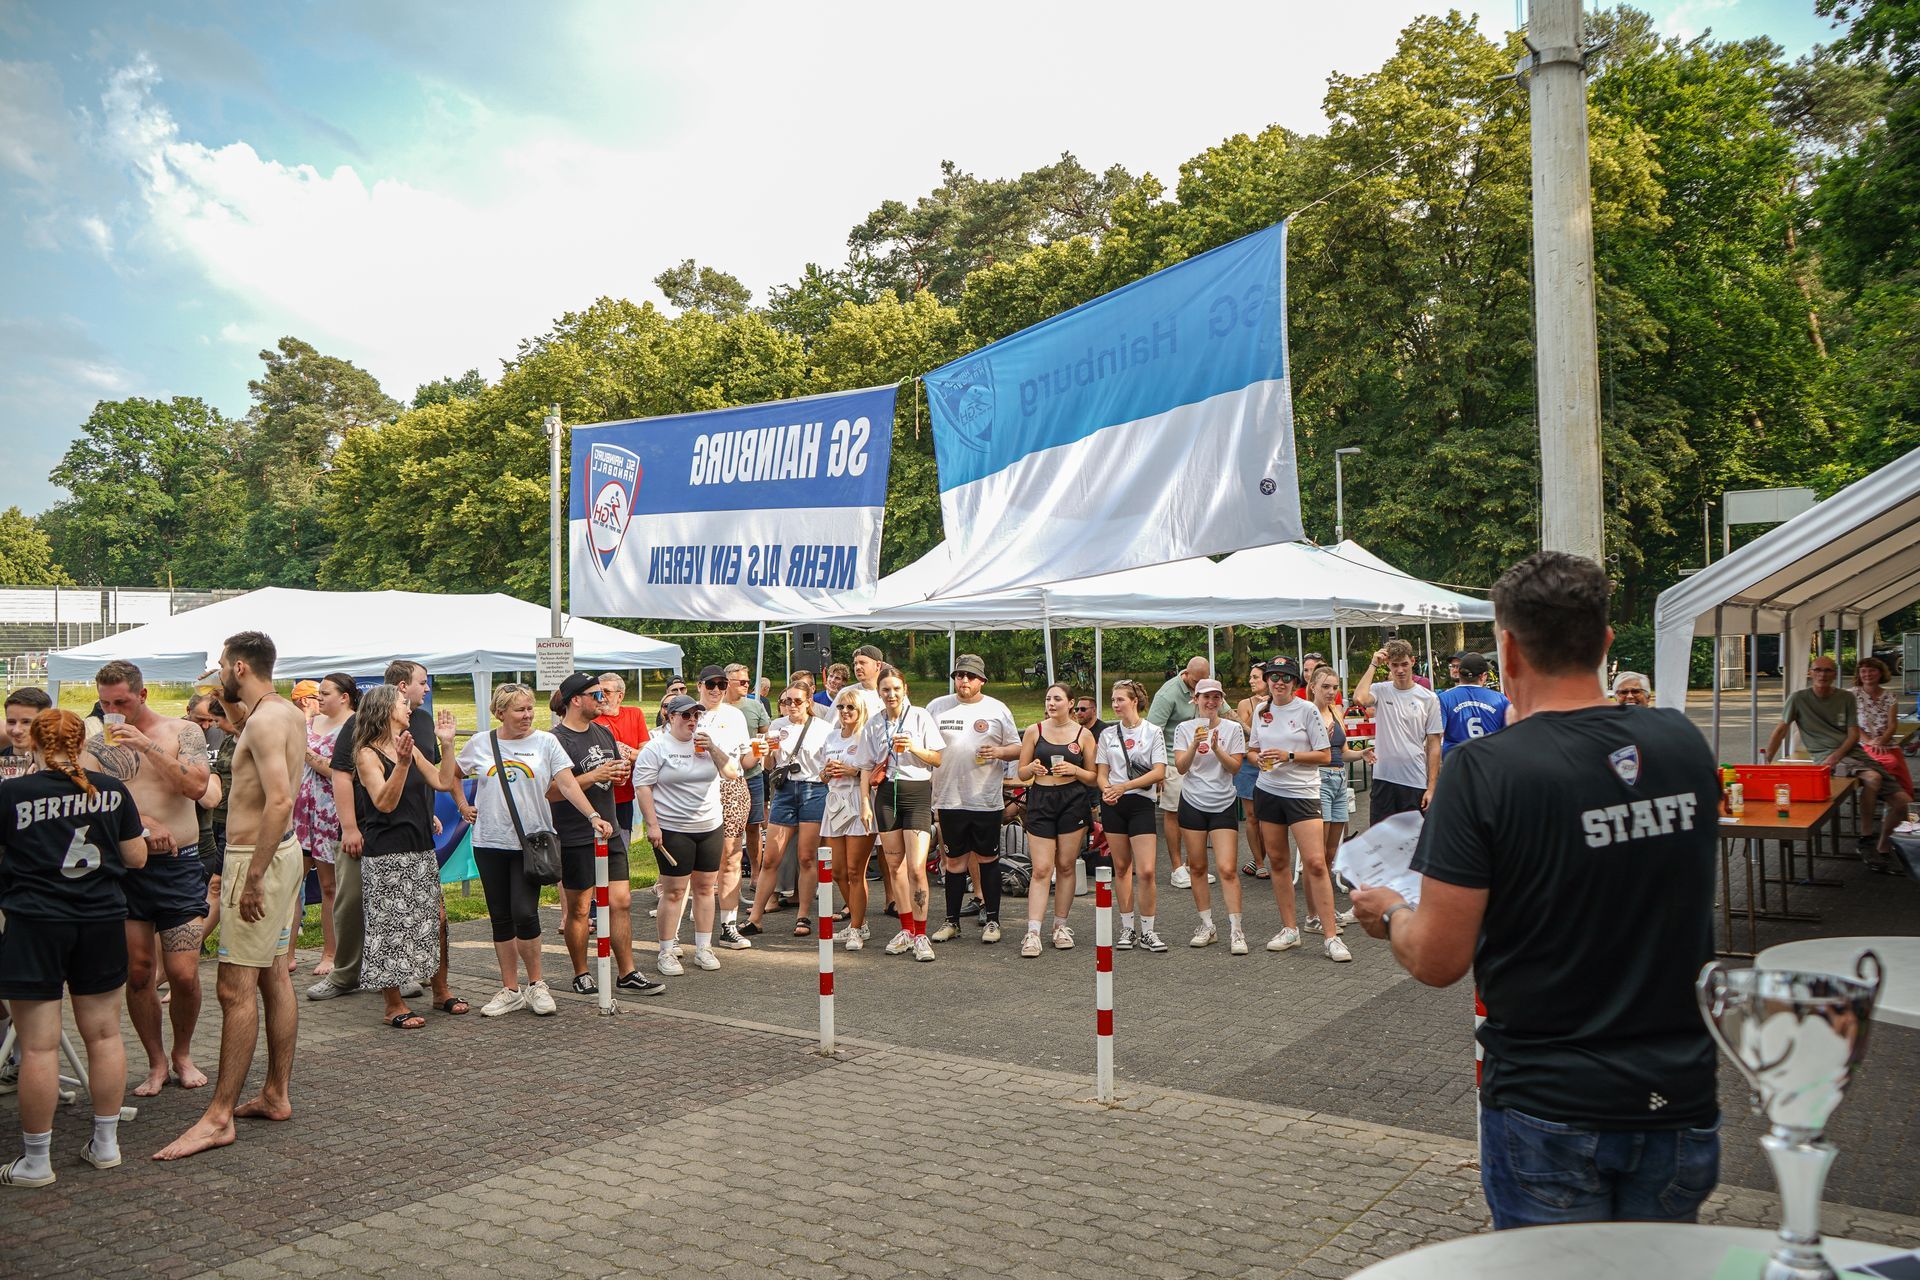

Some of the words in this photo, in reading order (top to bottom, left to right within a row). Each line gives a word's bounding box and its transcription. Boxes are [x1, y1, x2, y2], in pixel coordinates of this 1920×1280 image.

[1467, 717, 1484, 738] 6
[16, 790, 122, 830] BERTHOLD
[1581, 792, 1698, 849] STAFF
[60, 825, 101, 878] 6
